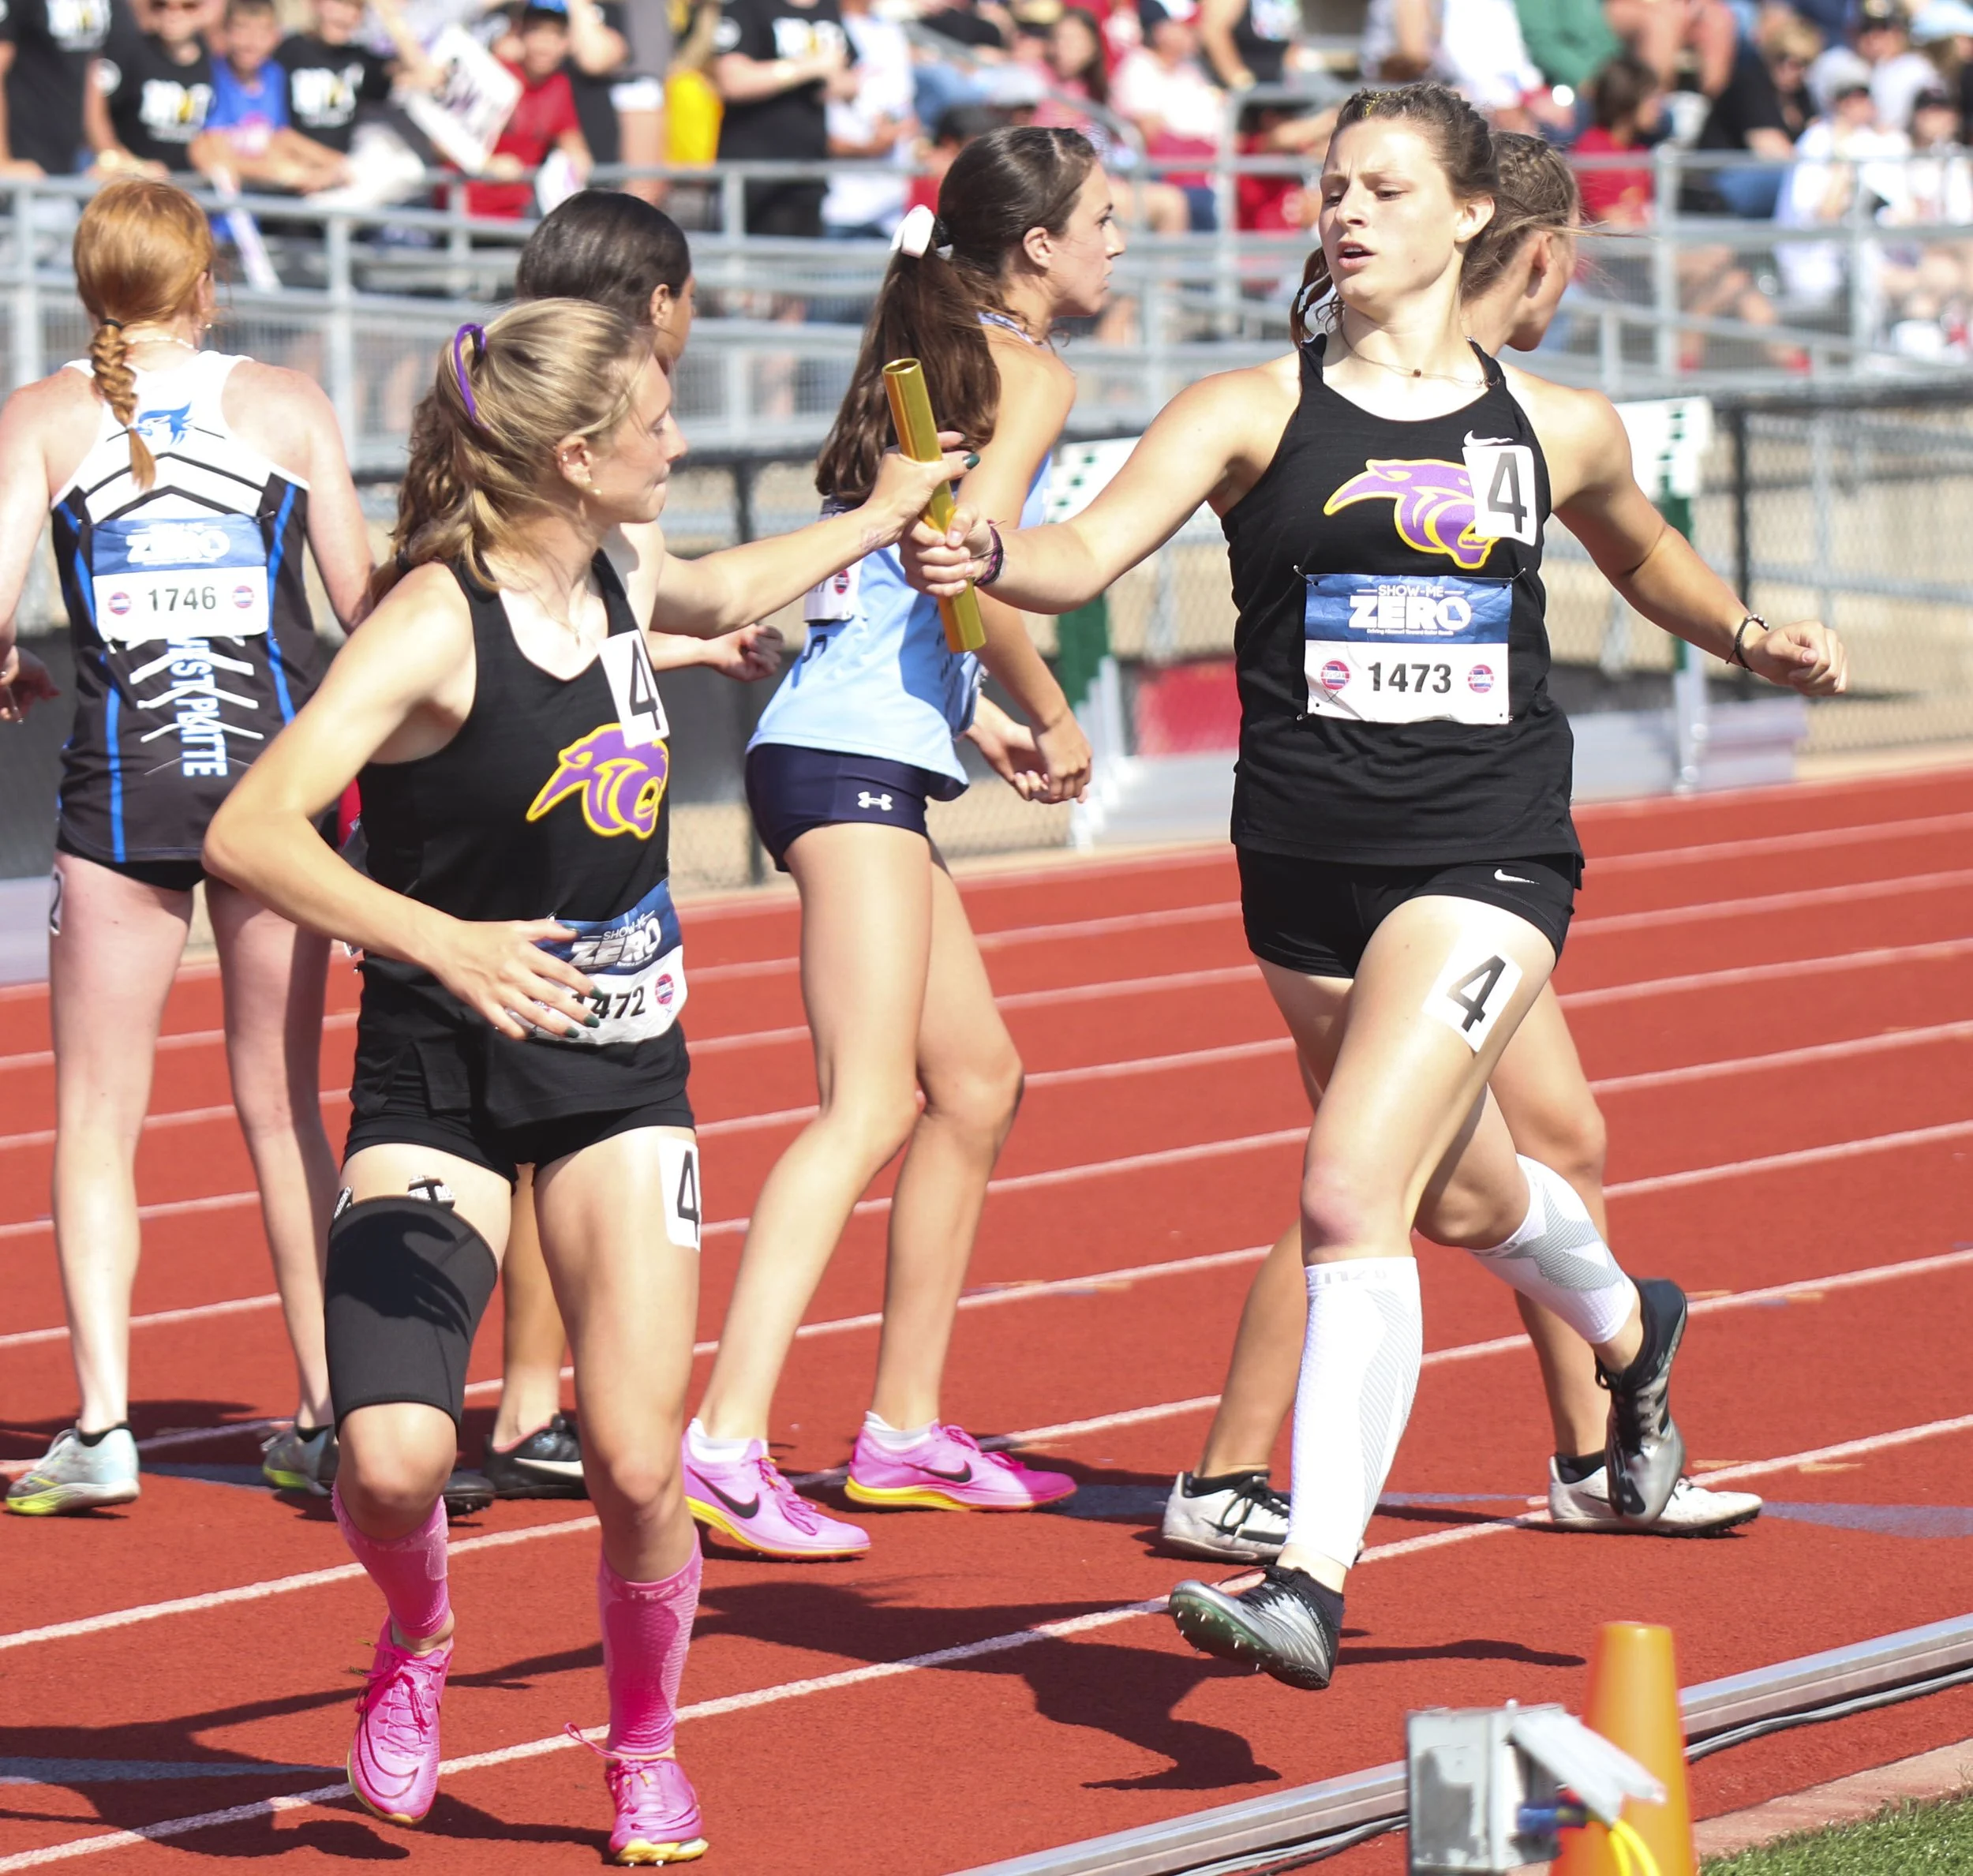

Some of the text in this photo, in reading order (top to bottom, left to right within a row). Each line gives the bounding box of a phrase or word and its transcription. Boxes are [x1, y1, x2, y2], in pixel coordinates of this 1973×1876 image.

[1487, 451, 1528, 535] 4
[148, 586, 217, 612] 1746
[1349, 595, 1472, 631] ZERO
[1378, 585, 1444, 597] SHOW-ME
[629, 638, 659, 731] 4
[1368, 661, 1452, 694] 1473
[569, 917, 661, 967] ZERO
[1446, 954, 1507, 1032] 4
[677, 1150, 700, 1242] 4
